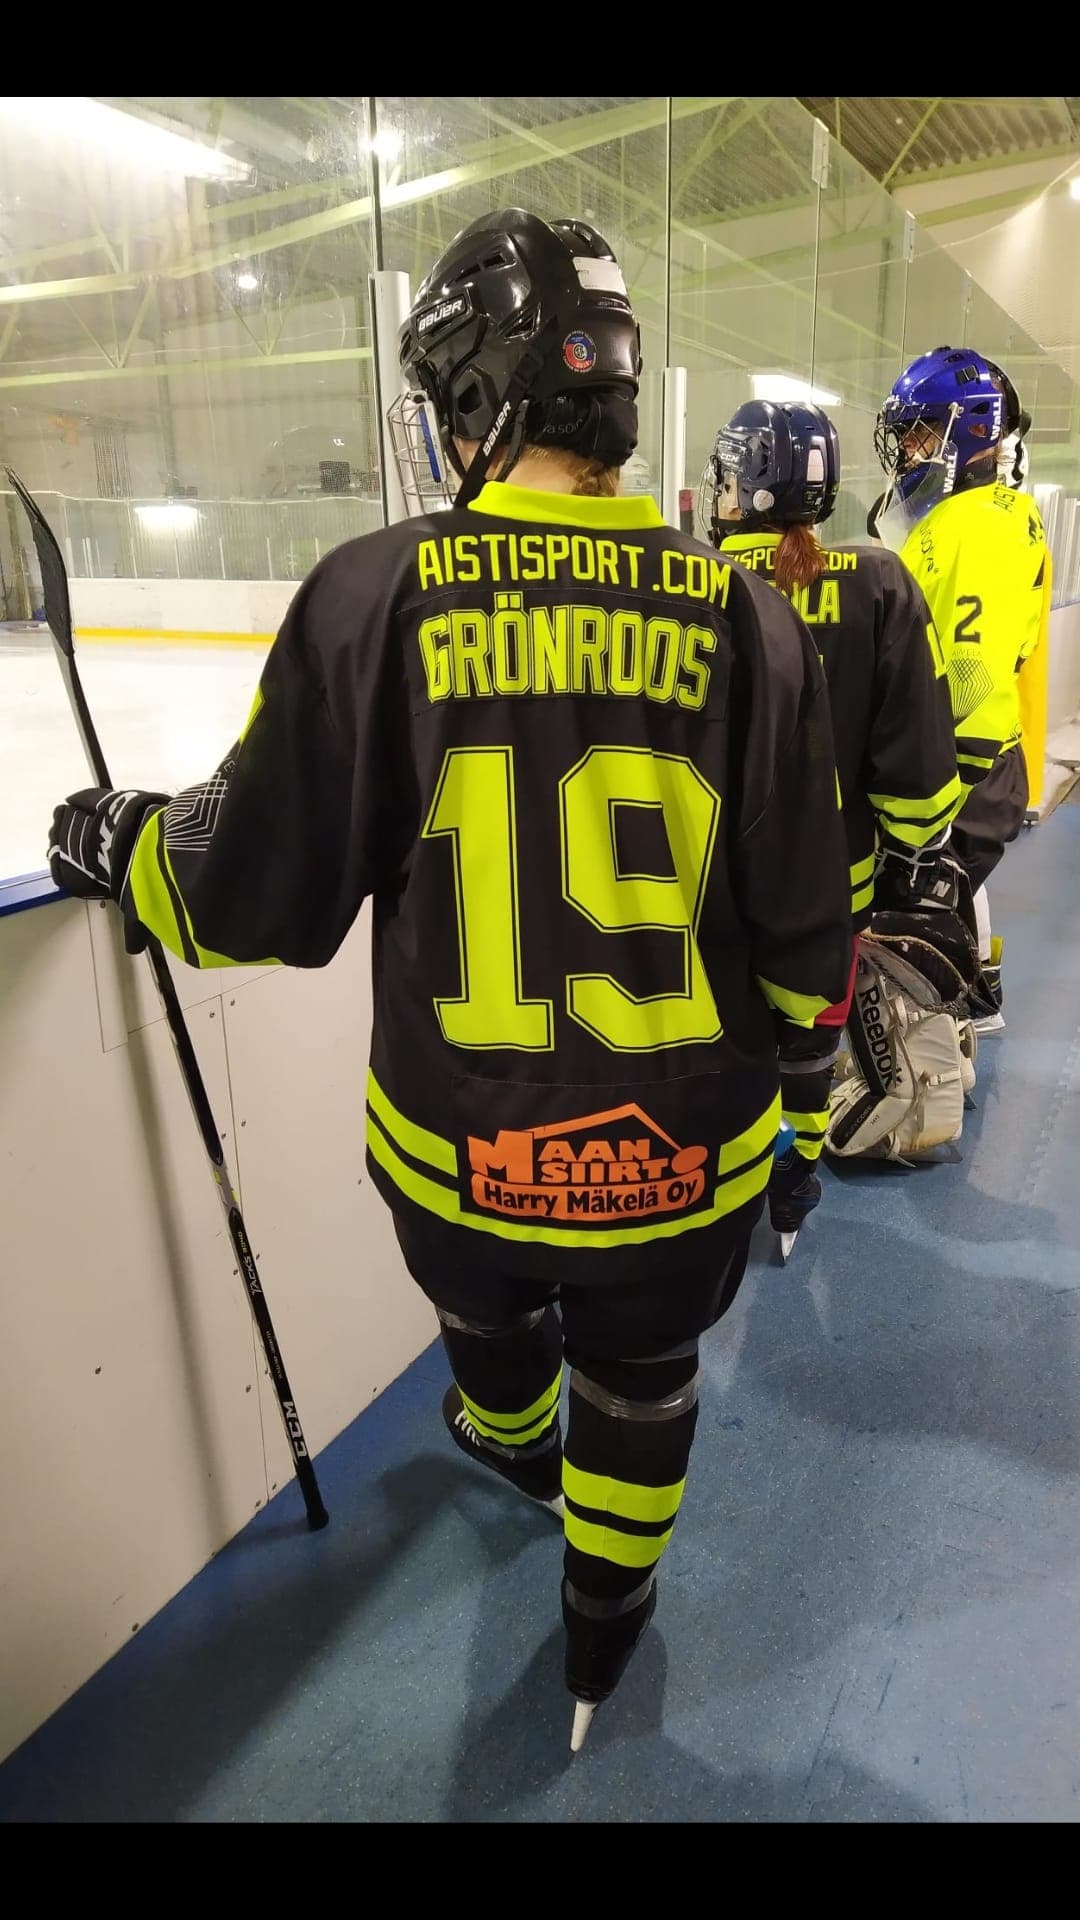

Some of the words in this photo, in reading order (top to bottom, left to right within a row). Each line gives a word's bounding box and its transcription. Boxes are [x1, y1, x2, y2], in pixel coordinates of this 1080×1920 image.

[418, 299, 463, 332] BAUER
[482, 400, 511, 457] BAUER
[954, 594, 983, 644] 2
[418, 591, 719, 711] GRÖNROOS
[421, 745, 724, 1053] 19
[483, 1181, 559, 1217] Harry
[566, 1185, 660, 1215] Mäkelä
[666, 1179, 698, 1207] Oy
[282, 1401, 308, 1458] CCM
